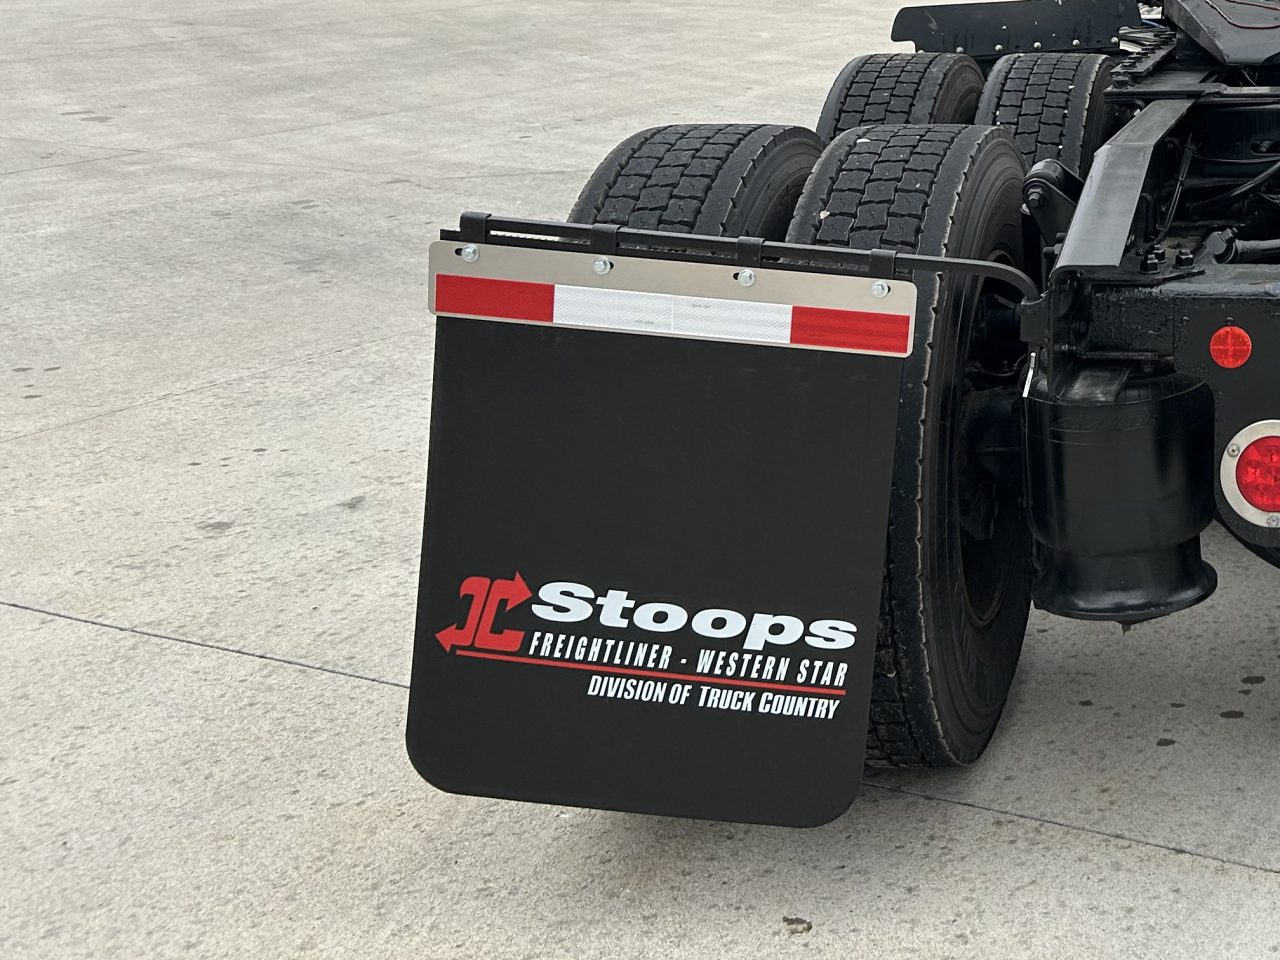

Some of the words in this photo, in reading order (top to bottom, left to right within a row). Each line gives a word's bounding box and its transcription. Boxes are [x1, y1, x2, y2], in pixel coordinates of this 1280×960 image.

[531, 581, 858, 651] Stoops
[528, 631, 673, 670] FREIGHTLINER
[695, 648, 791, 682] WESTERN
[796, 658, 848, 687] STAR
[587, 674, 668, 703] DIVISION
[668, 683, 693, 705] OF
[698, 685, 757, 712] TRUCK
[758, 691, 841, 720] COUNTRY
